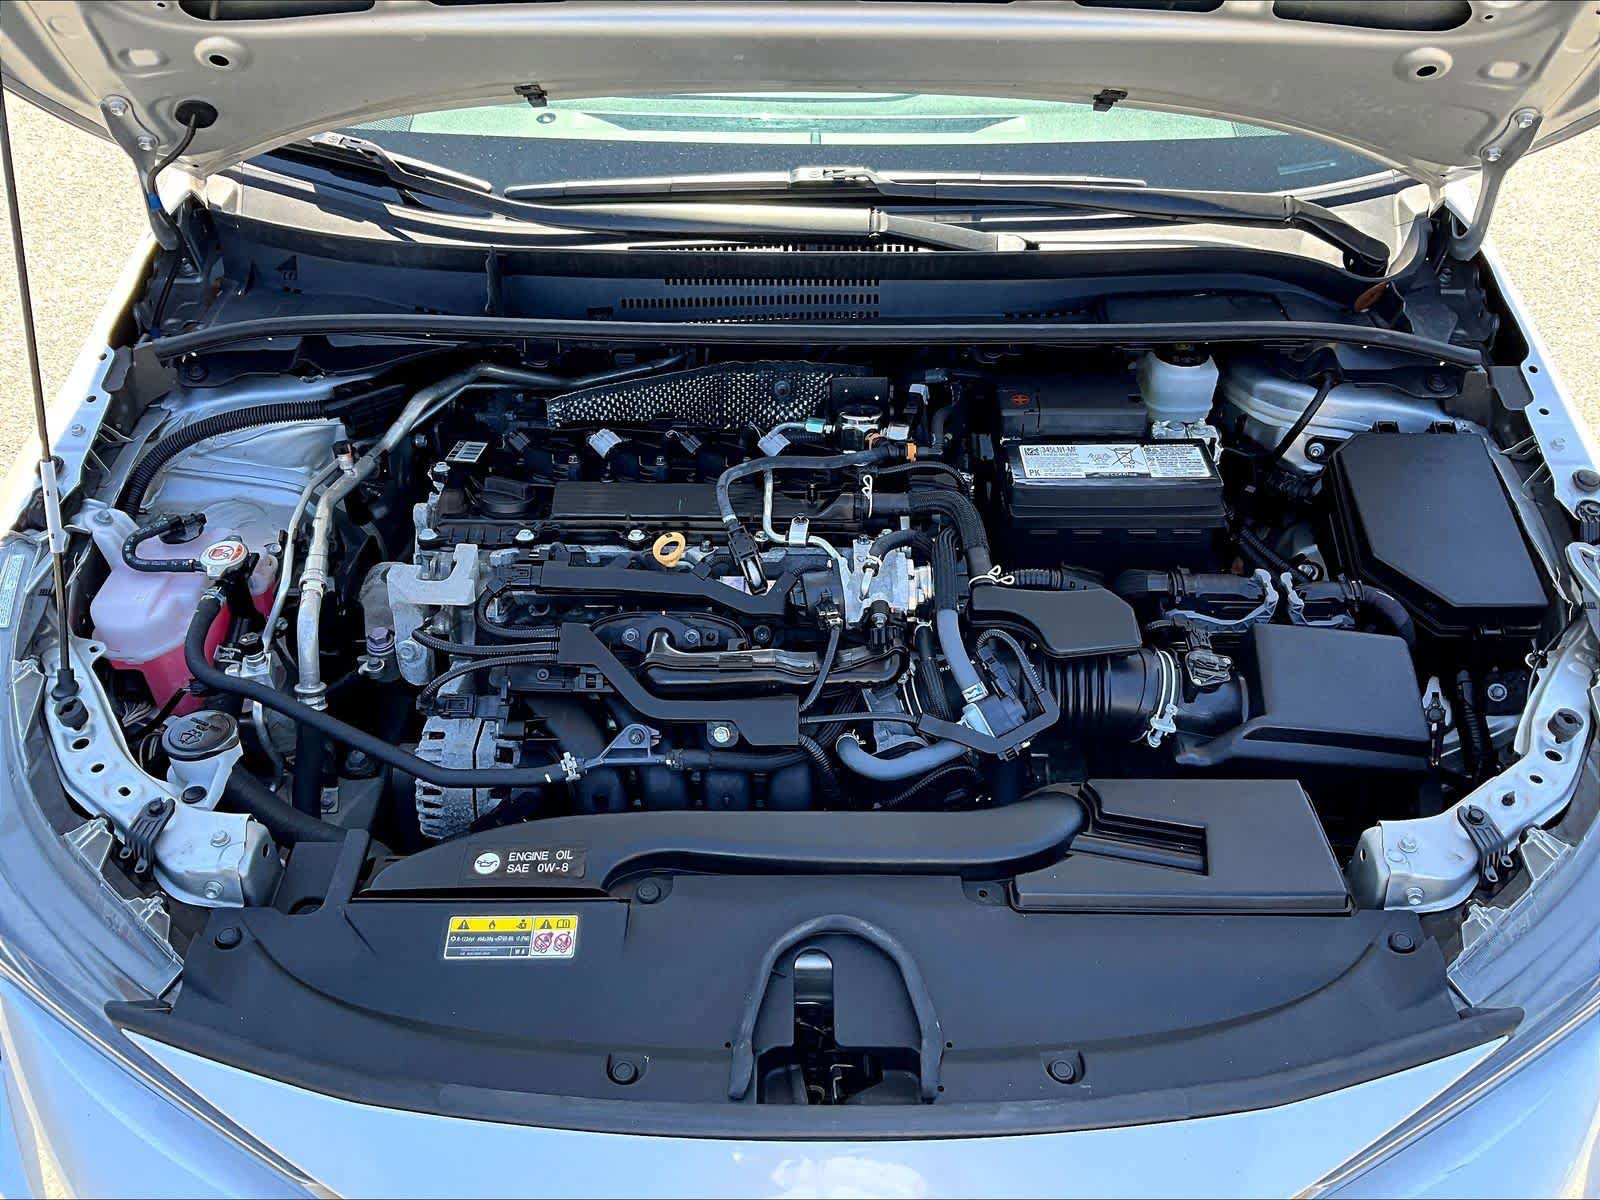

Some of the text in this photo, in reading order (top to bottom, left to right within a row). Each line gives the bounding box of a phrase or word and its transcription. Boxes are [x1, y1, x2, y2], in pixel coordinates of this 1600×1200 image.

[1029, 469, 1041, 477] PK
[508, 850, 574, 862] ENGINE OIL
[506, 862, 569, 873] SAE 0W-8
